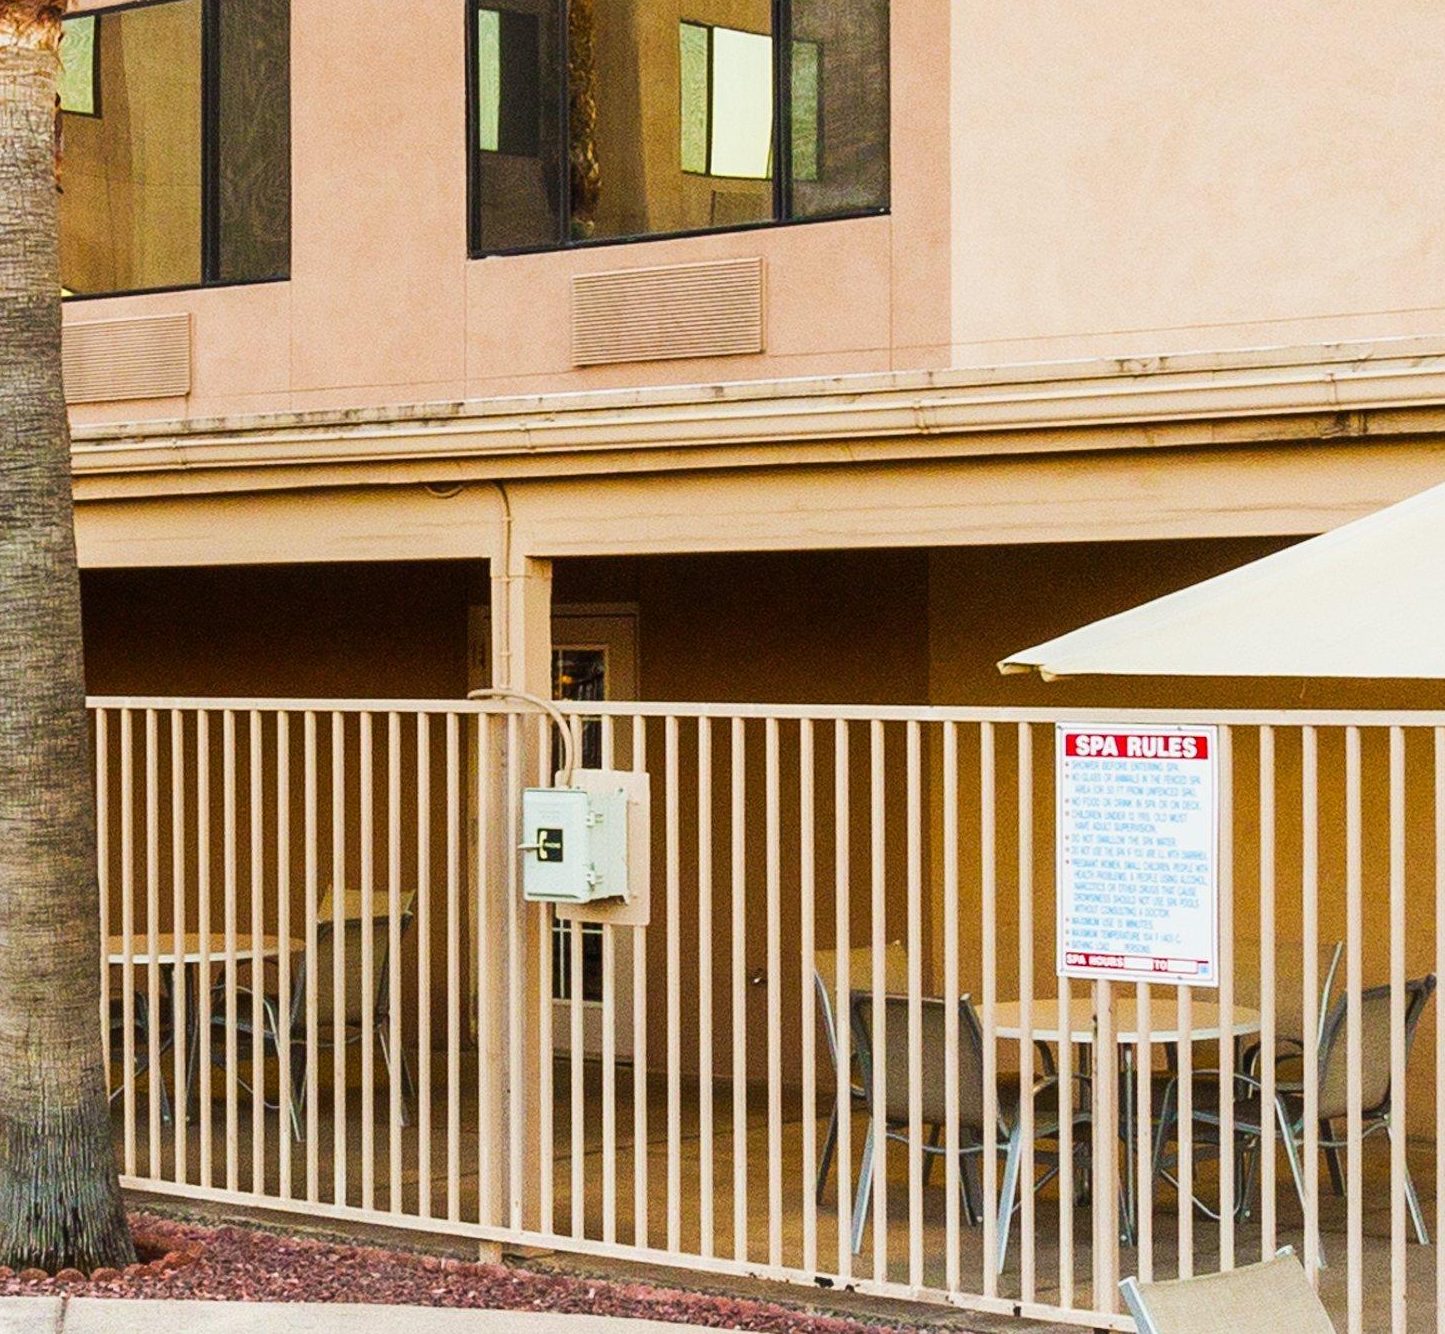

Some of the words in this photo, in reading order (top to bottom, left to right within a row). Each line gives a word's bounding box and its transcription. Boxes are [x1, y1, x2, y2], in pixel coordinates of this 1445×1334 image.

[1075, 735, 1119, 756] SPA
[1127, 736, 1197, 758] RULES
[1067, 953, 1086, 965] SPA
[1089, 955, 1124, 968] HOURS
[1155, 960, 1167, 971] TO
